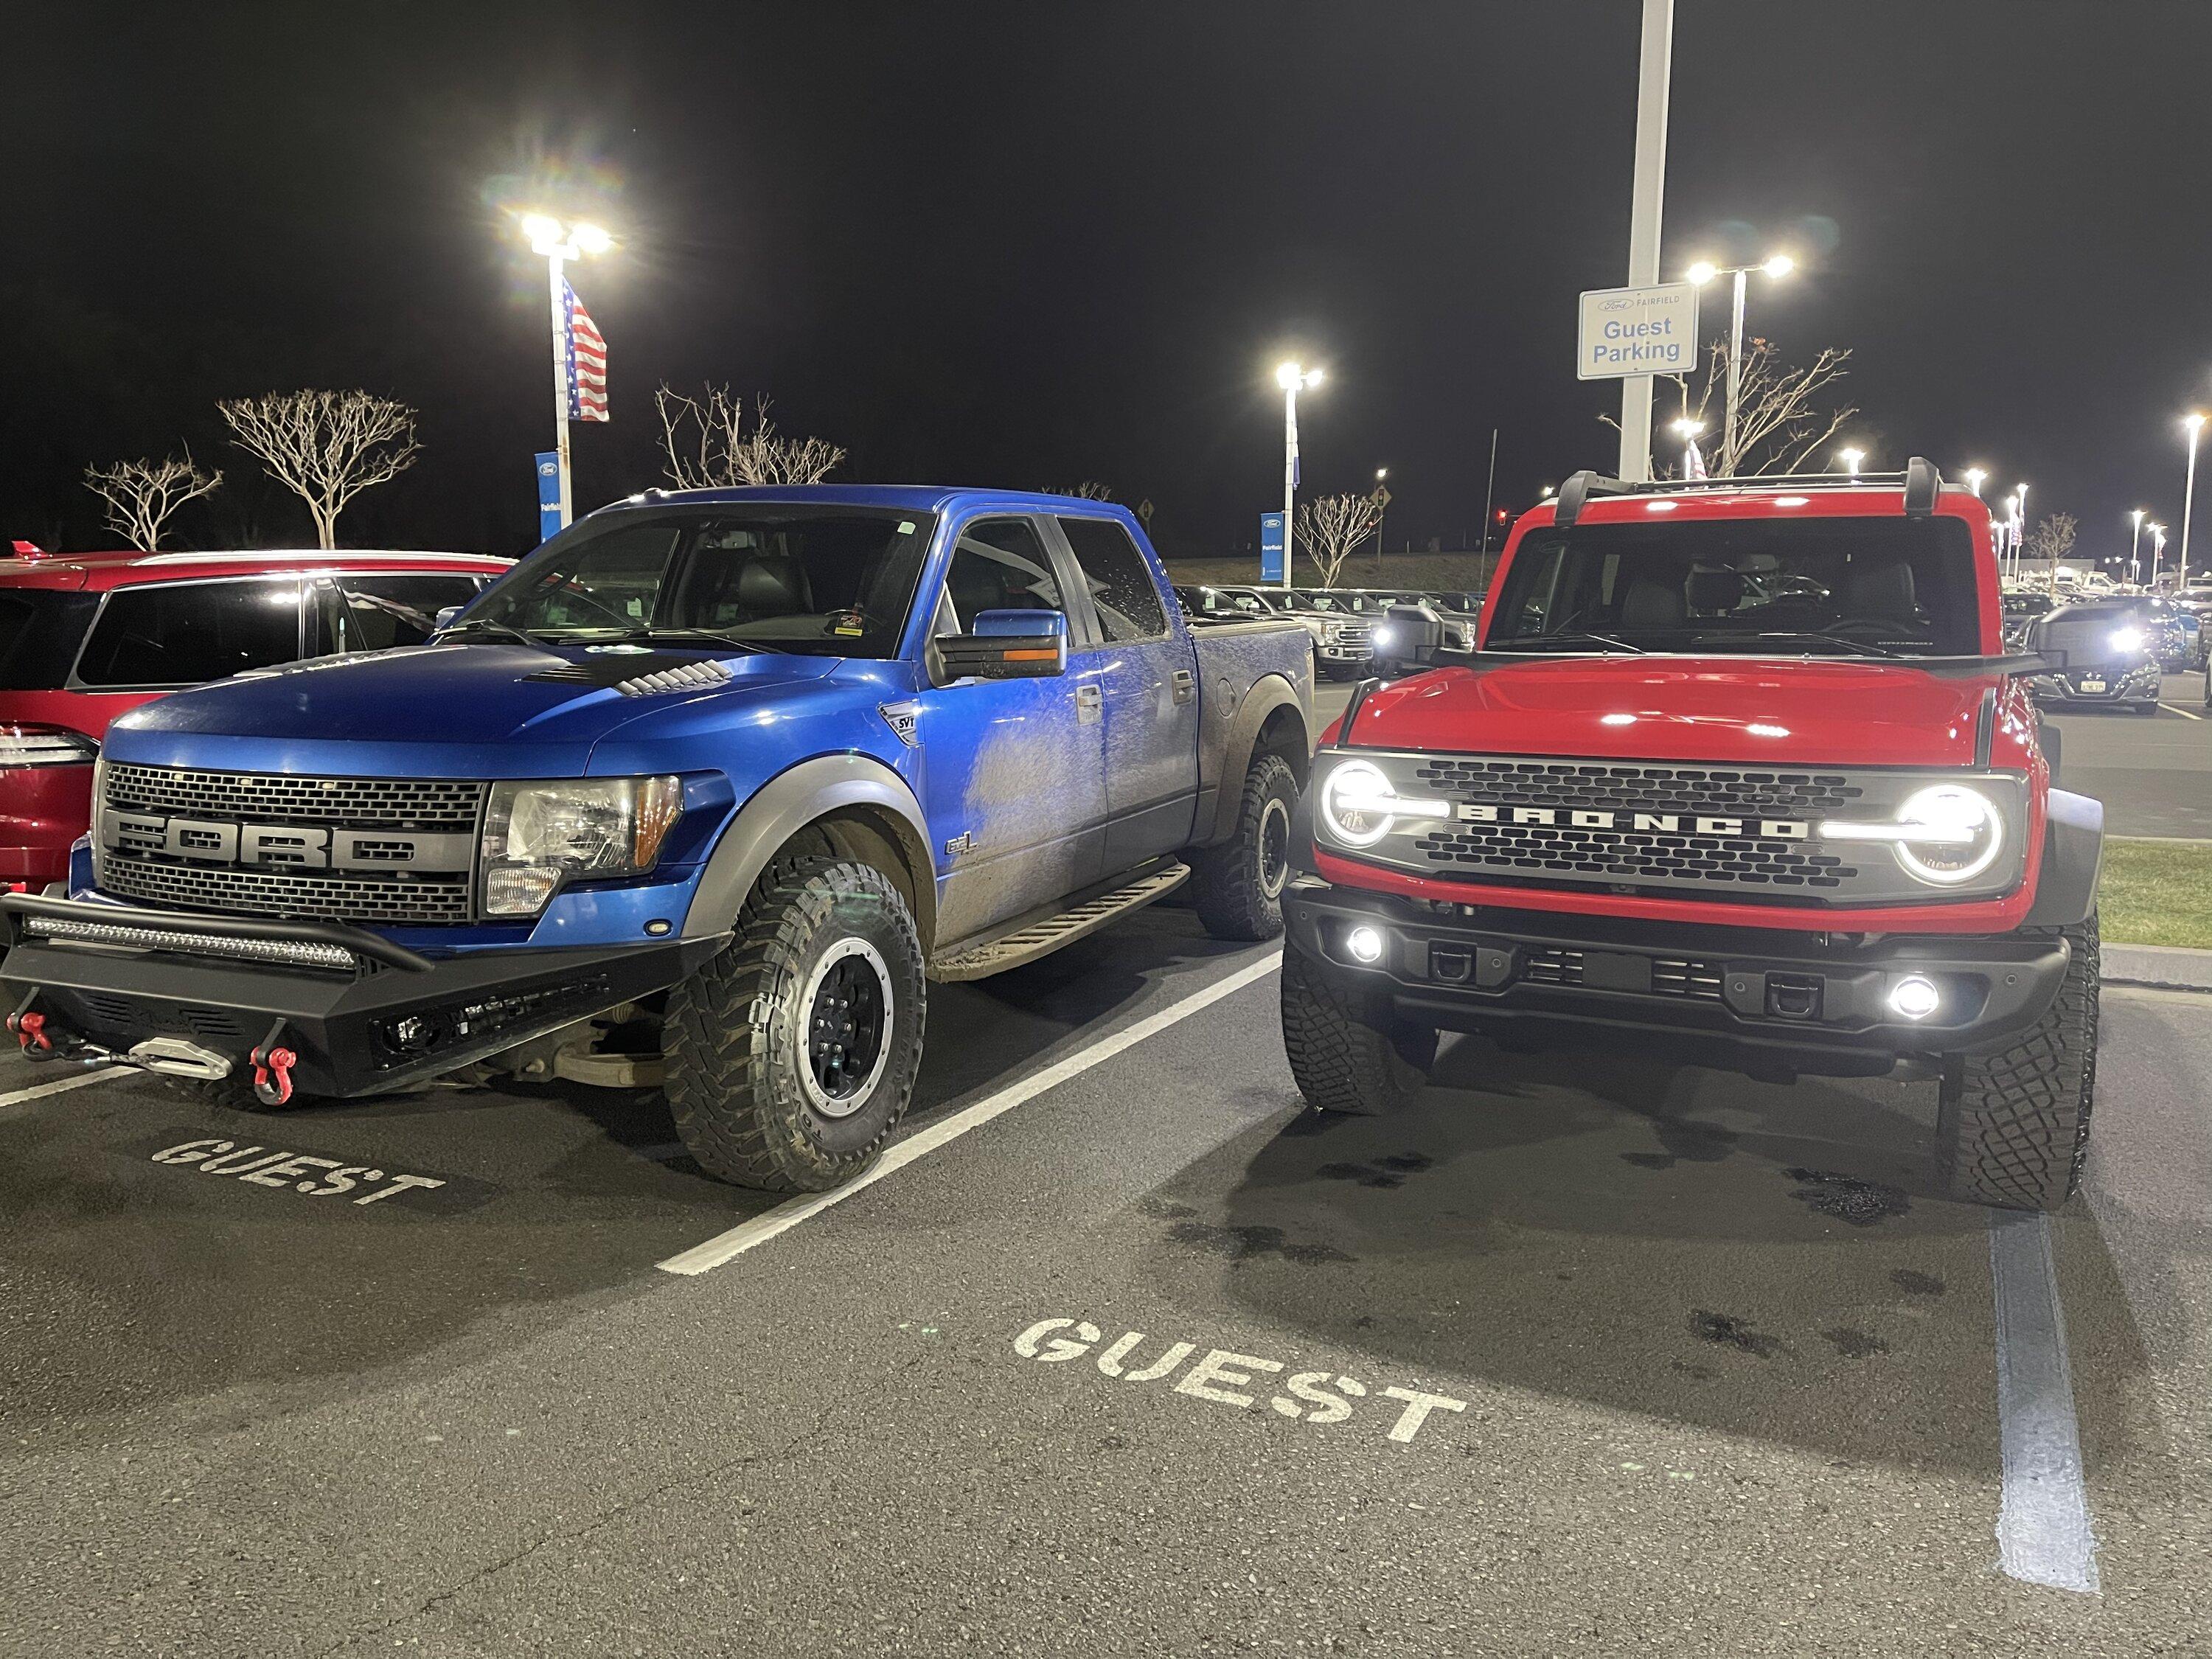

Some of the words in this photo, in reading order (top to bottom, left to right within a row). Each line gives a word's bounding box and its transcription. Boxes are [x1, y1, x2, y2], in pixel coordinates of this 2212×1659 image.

[1636, 296, 1680, 307] FAIRFIELD
[1604, 317, 1672, 339] Guest
[1593, 341, 1680, 364] Parking
[1457, 804, 1809, 838] BRONCO
[104, 809, 472, 872] FORD
[152, 1139, 446, 1205] GUEST
[1014, 1318, 1468, 1443] GUEST
